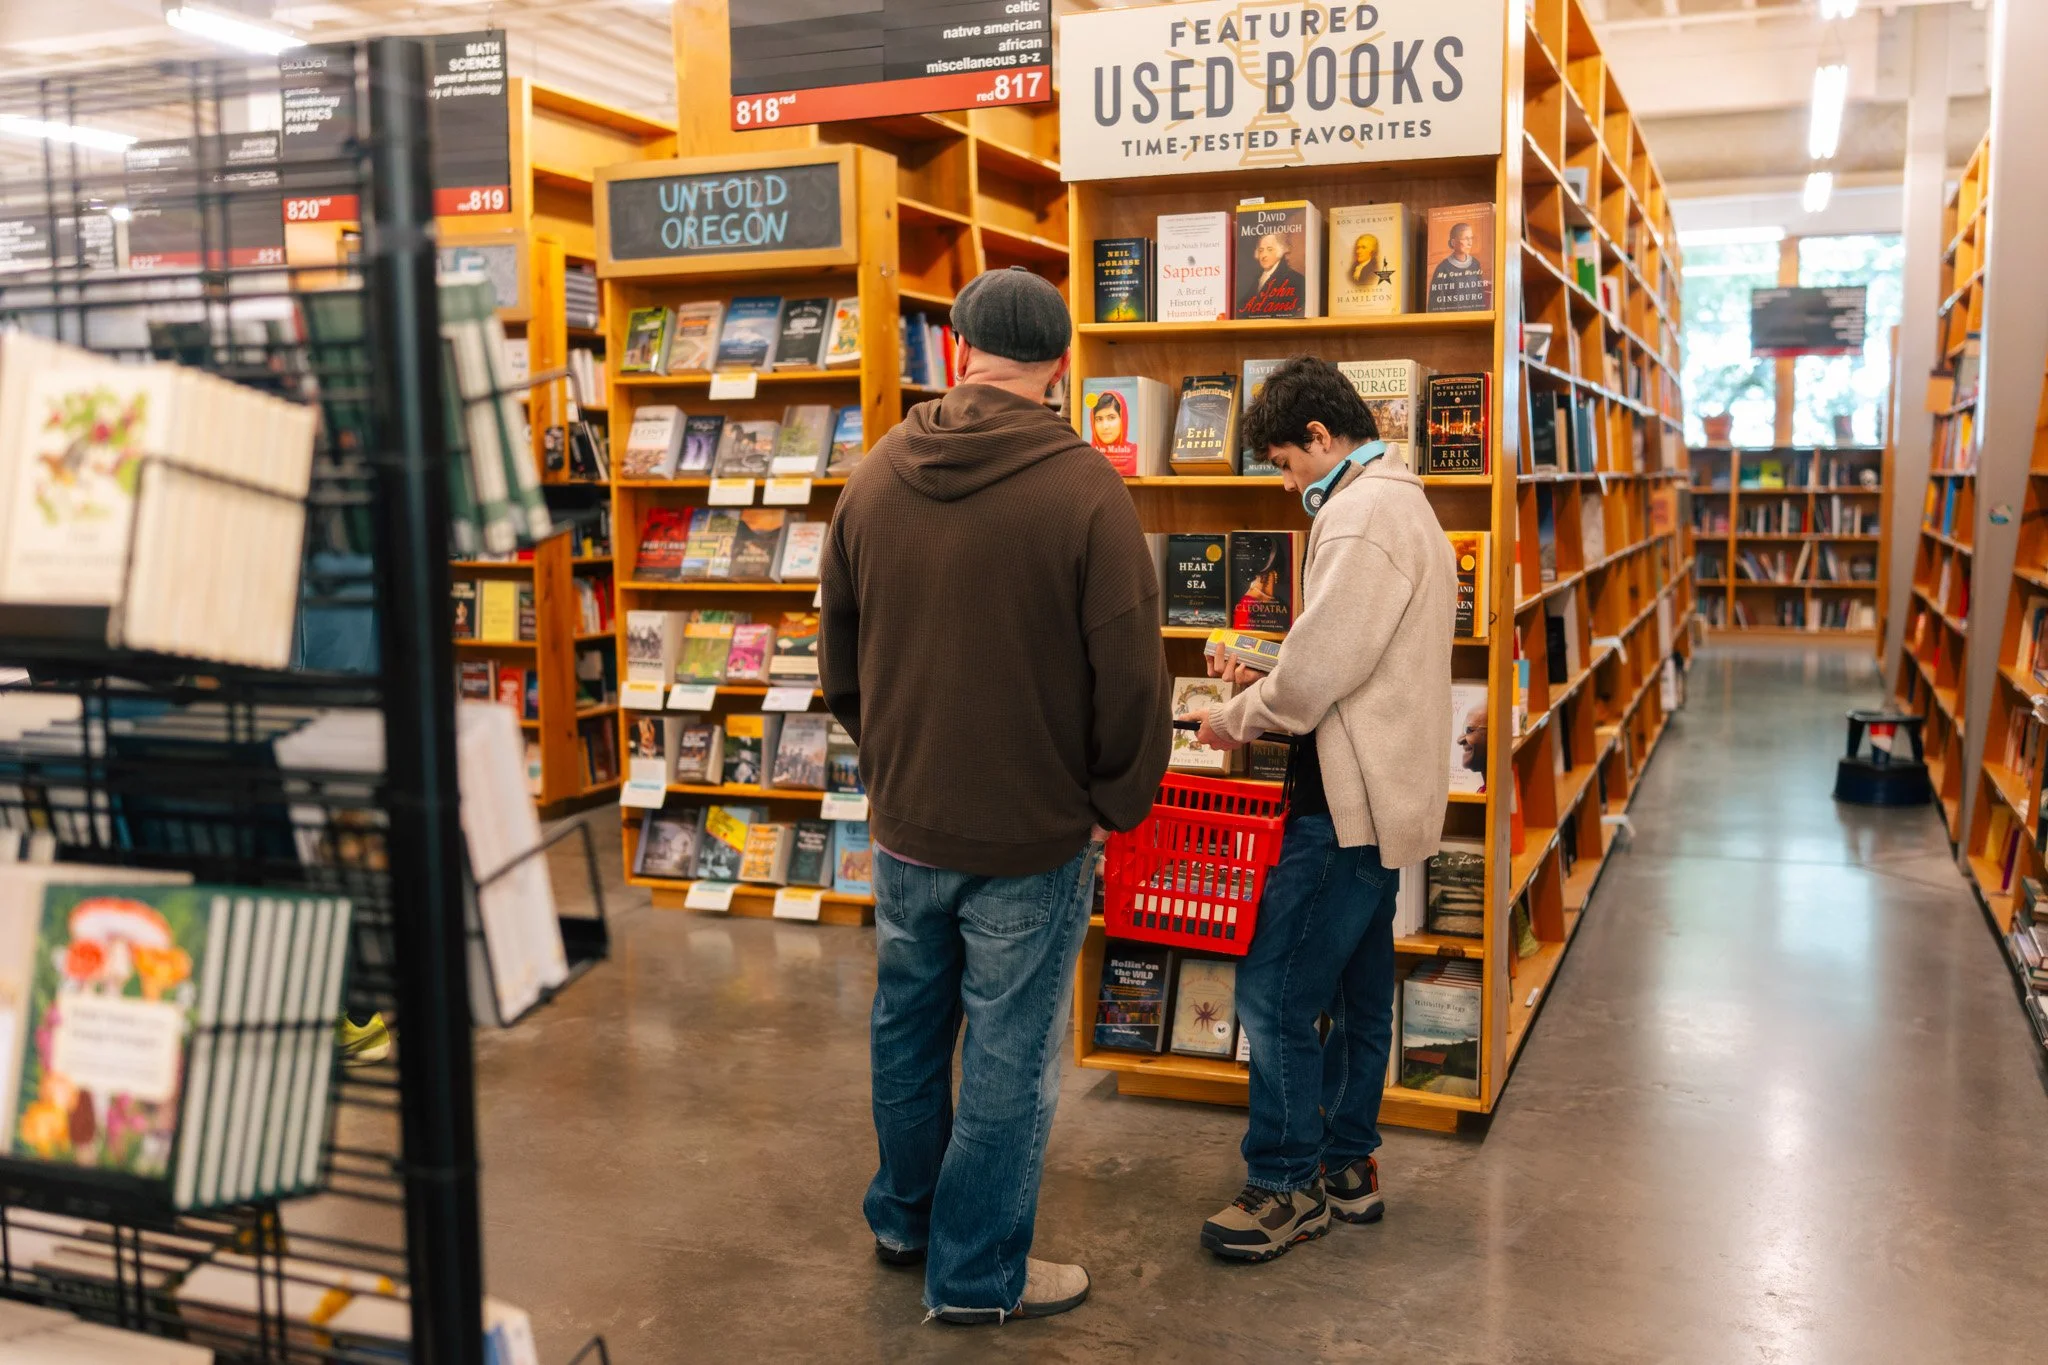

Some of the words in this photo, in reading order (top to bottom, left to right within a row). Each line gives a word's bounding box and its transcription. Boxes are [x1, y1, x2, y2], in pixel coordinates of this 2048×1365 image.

[1005, 1, 1040, 14] celtic
[943, 25, 981, 40] native
[984, 18, 1043, 36] american
[1170, 4, 1379, 47] FEATURED
[465, 42, 501, 57] MATH
[998, 37, 1043, 51] african
[448, 55, 502, 72] SCIENCE
[927, 56, 1017, 74] miscellaneous
[1019, 51, 1041, 65] a-z
[433, 73, 467, 88] general
[467, 69, 504, 82] science
[1094, 56, 1235, 127] USED
[1266, 36, 1465, 114] BOOKS
[452, 83, 503, 98] technology
[977, 89, 994, 102] red
[994, 72, 1043, 100] 817
[284, 107, 333, 123] PHYSICS
[736, 99, 780, 125] 818
[779, 94, 796, 107] red
[1122, 130, 1279, 157] TIME-TESTED
[1290, 120, 1432, 146] FAVORITES
[469, 189, 505, 211] 819
[658, 175, 788, 213] UNTOLD
[287, 200, 319, 219] 820
[1258, 211, 1286, 223] DAVID
[1356, 215, 1395, 224] CHERNOW
[661, 211, 788, 249] OREGON
[1104, 268, 1133, 276] TYSON
[1163, 264, 1221, 282] Sapiens
[1177, 288, 1185, 296] A
[1186, 287, 1206, 296] Brief
[1260, 279, 1295, 298] John
[1431, 282, 1455, 292] RUTH
[1459, 280, 1489, 290] BADER
[1170, 299, 1198, 310] History
[1199, 298, 1214, 306] of
[1337, 294, 1392, 305] HAMILTON
[1437, 293, 1483, 303] GINSBURG
[1167, 309, 1217, 319] Humankind
[1182, 386, 1233, 400] Thunderstruck
[1352, 379, 1407, 393] OURAGE
[1186, 427, 1217, 439] Erik
[1176, 438, 1222, 449] Larson
[1442, 449, 1469, 459] ERIK
[1432, 458, 1479, 468] LARSON
[1179, 562, 1214, 572] HEART
[1187, 581, 1206, 589] SEA
[1235, 603, 1288, 614] CLEOPATRA
[1114, 969, 1132, 977] the
[1132, 969, 1154, 980] WILD
[1119, 976, 1147, 986] River
